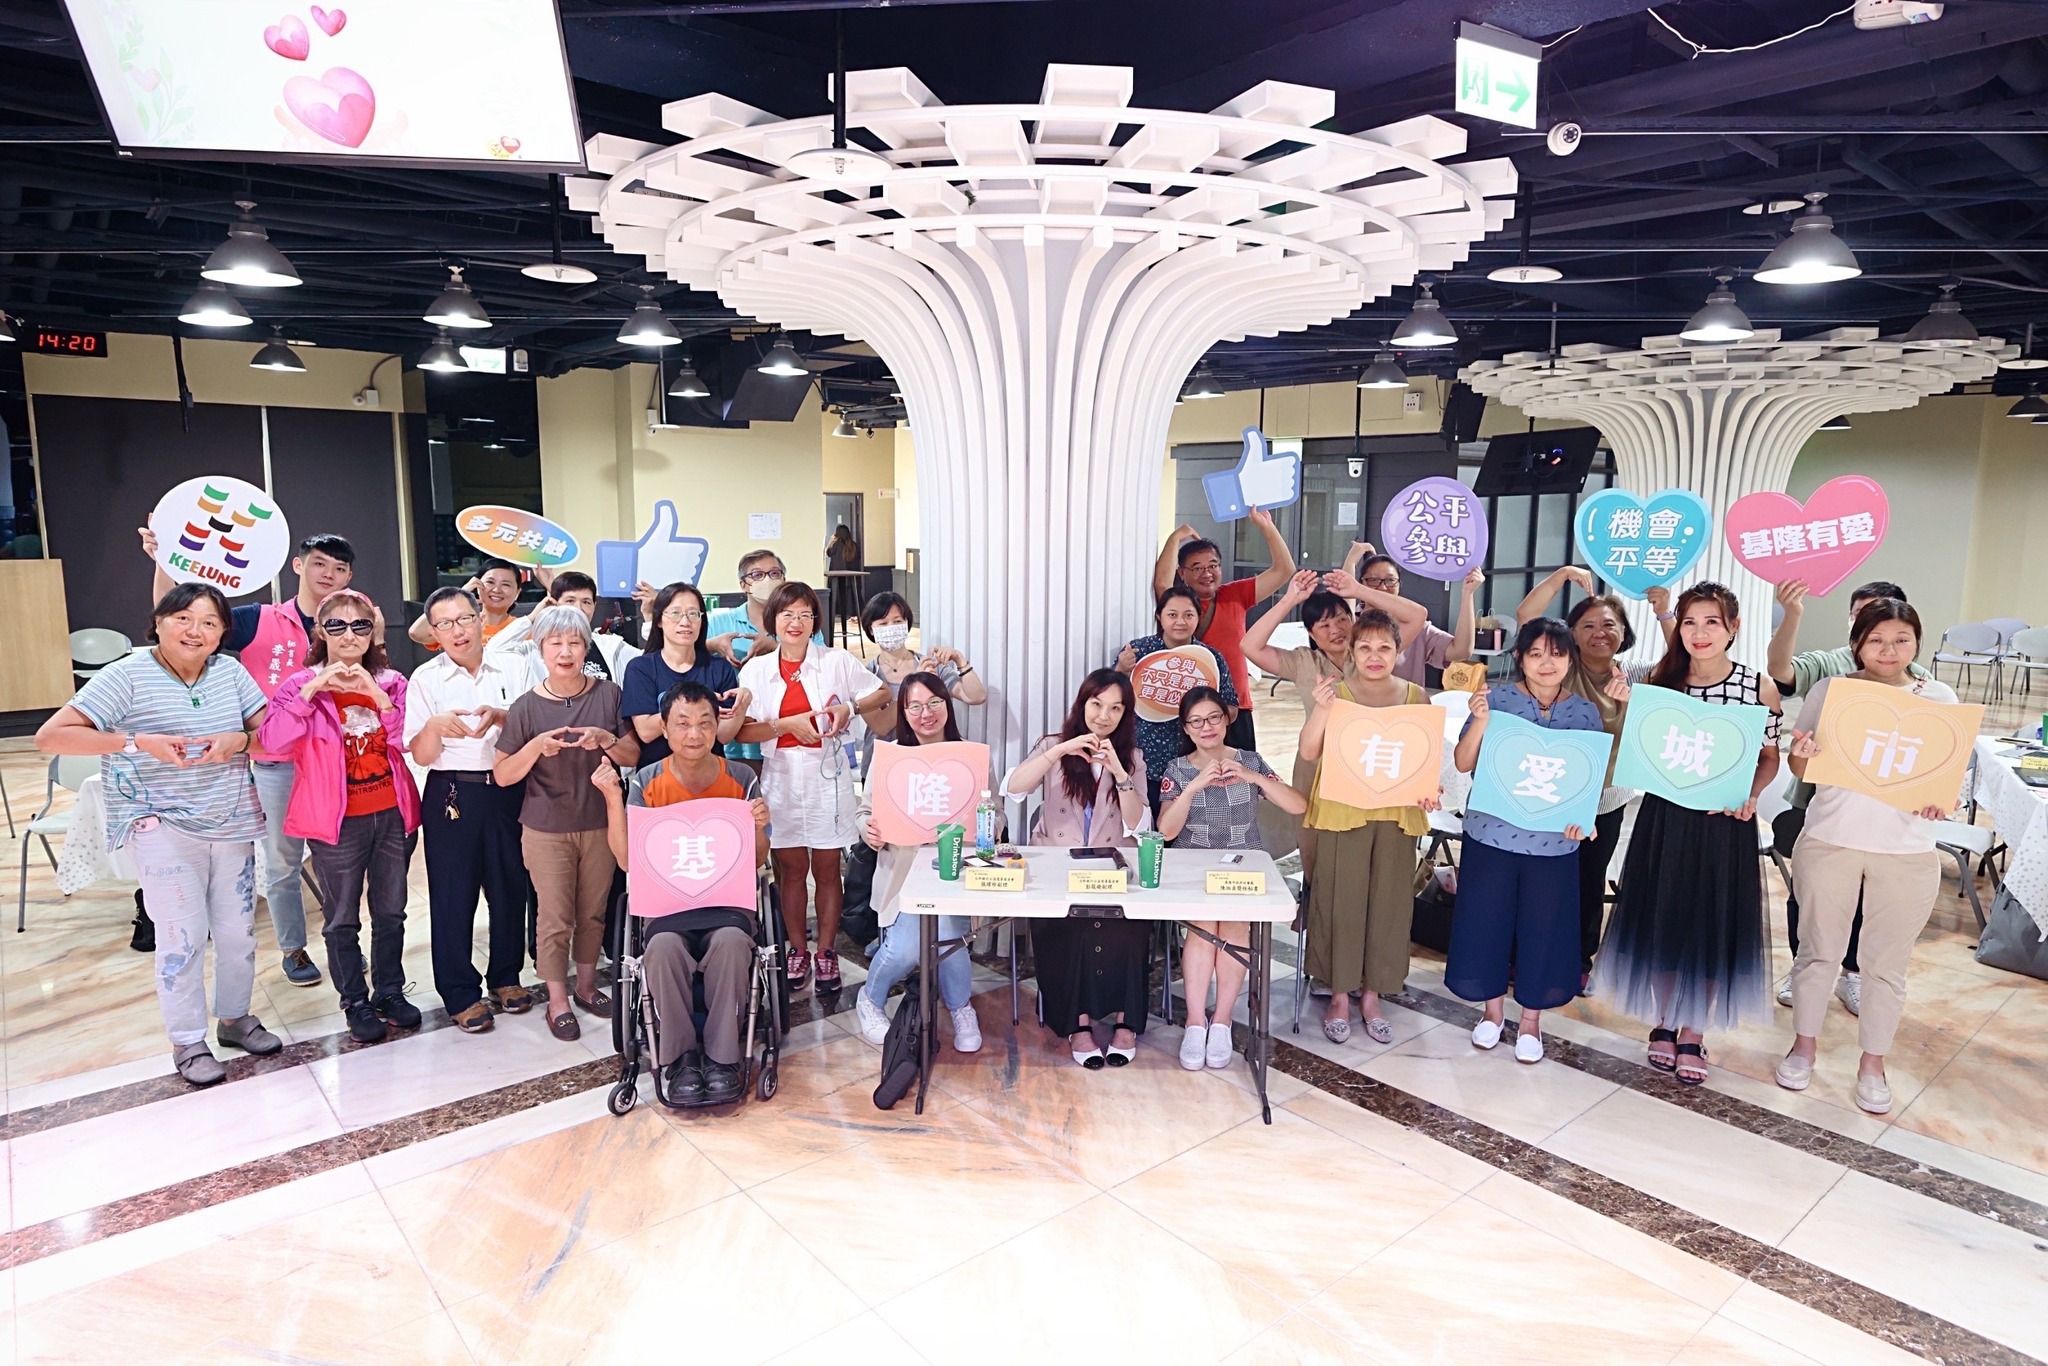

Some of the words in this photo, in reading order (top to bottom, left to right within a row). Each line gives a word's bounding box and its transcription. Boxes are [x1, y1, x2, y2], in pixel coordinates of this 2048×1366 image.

[38, 334, 96, 351] 14:20
[1403, 491, 1470, 528] 公平
[1607, 508, 1683, 540] 機會
[464, 514, 569, 560] 多元共融
[1400, 525, 1471, 566] 參與
[1740, 511, 1876, 560] 基隆有愛
[168, 552, 242, 589] KEELUNG
[1604, 545, 1681, 577] 平等
[1139, 685, 1181, 704] 更是必
[1359, 734, 1404, 778] 有
[1660, 725, 1714, 777] 城
[1860, 729, 1924, 778] 市
[908, 773, 952, 816] 隆
[1513, 754, 1567, 803] 愛
[669, 835, 716, 880] 基
[951, 837, 961, 877] Drinkstore
[1153, 844, 1162, 884] Drinkstore
